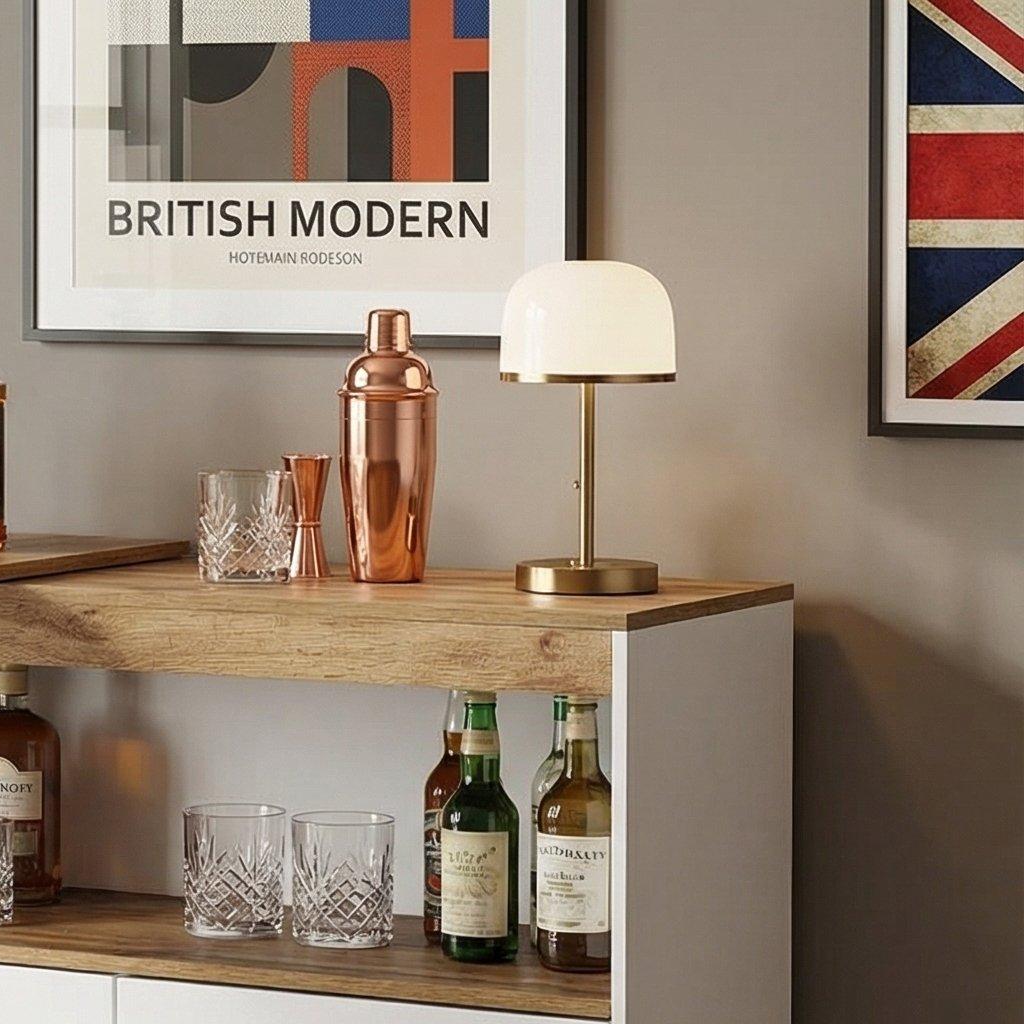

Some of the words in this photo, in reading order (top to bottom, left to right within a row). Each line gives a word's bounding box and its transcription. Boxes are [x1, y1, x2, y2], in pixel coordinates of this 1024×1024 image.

[108, 200, 275, 237] BRITISH
[290, 200, 489, 238] MODERN
[300, 251, 363, 265] RODESON
